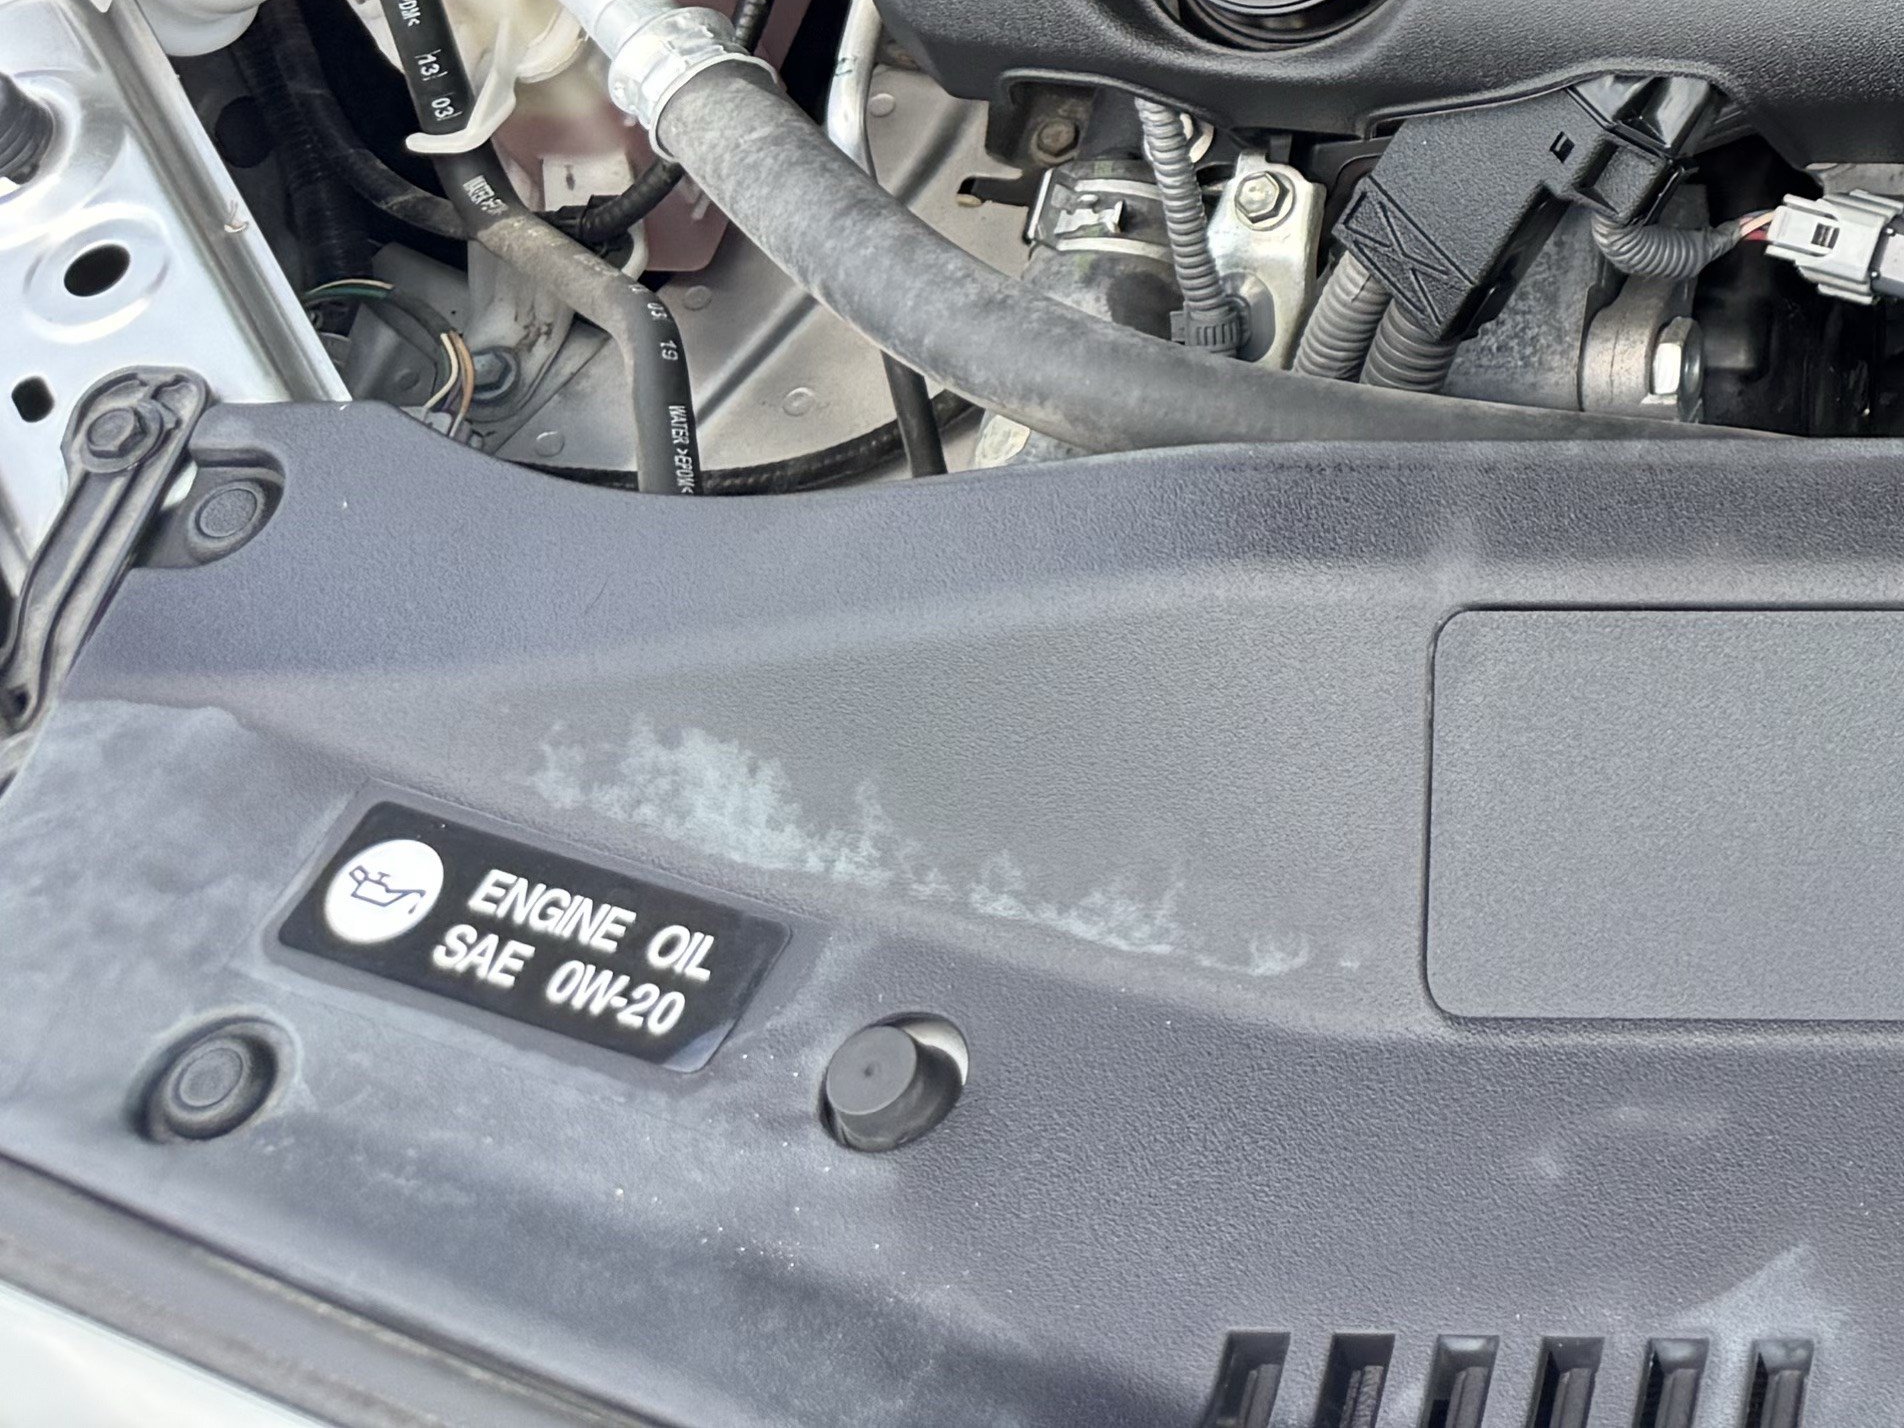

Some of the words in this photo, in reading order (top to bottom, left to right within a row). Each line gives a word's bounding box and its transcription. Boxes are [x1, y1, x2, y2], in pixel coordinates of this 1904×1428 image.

[659, 339, 679, 362] 19
[668, 404, 690, 445] WATER
[467, 868, 637, 954] ENGINE
[646, 924, 715, 982] OIL
[431, 923, 536, 989] SAE
[546, 959, 686, 1036] 0W-20
